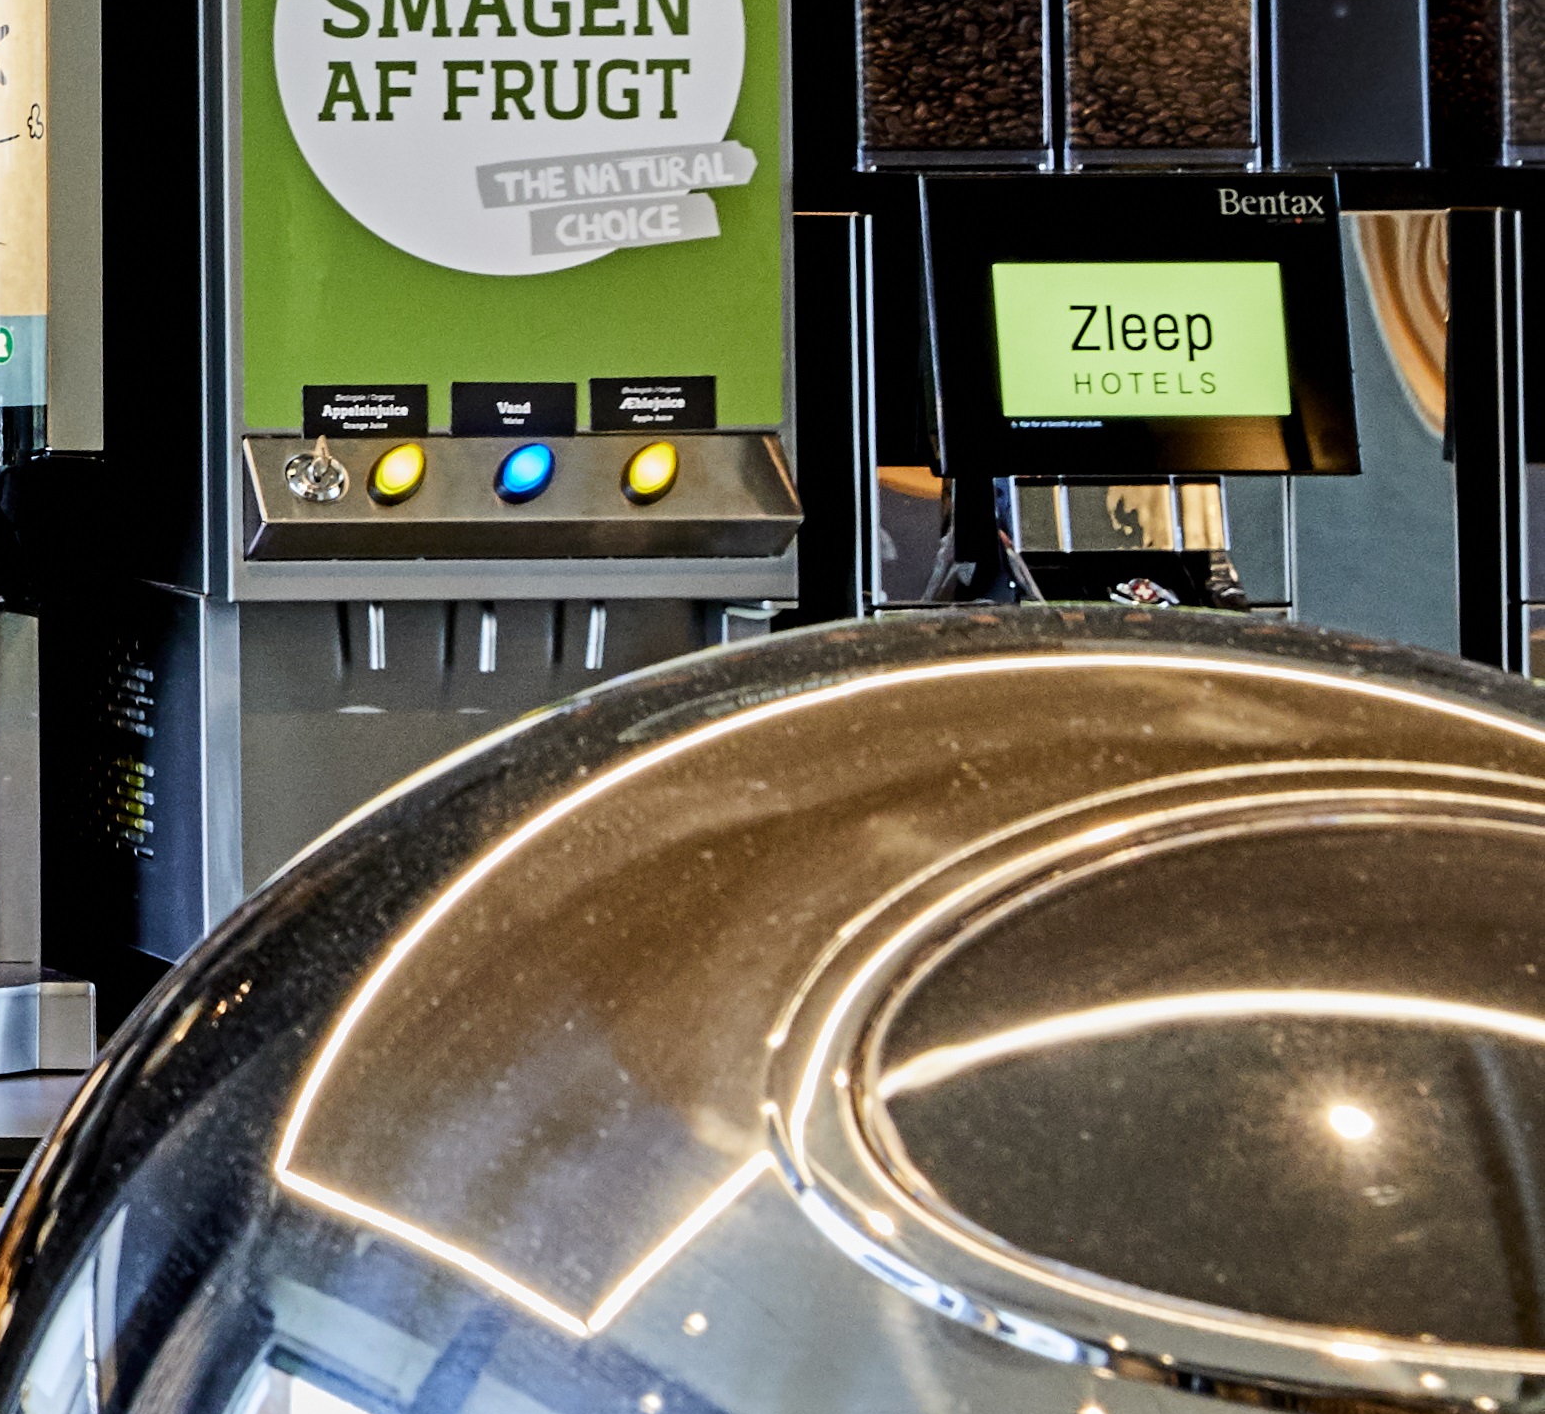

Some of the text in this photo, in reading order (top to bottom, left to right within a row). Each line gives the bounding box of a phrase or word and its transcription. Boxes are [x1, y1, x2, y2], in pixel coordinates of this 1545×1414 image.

[317, 58, 690, 122] AF FRUGT
[493, 150, 735, 204] THE NATURAL
[1217, 188, 1325, 215] Bentax
[555, 204, 682, 247] CHOICE
[1070, 305, 1214, 361] Zleep
[1073, 372, 1218, 395] HOTELS
[322, 404, 409, 420] Appelsinjuice
[496, 401, 531, 415] Vand
